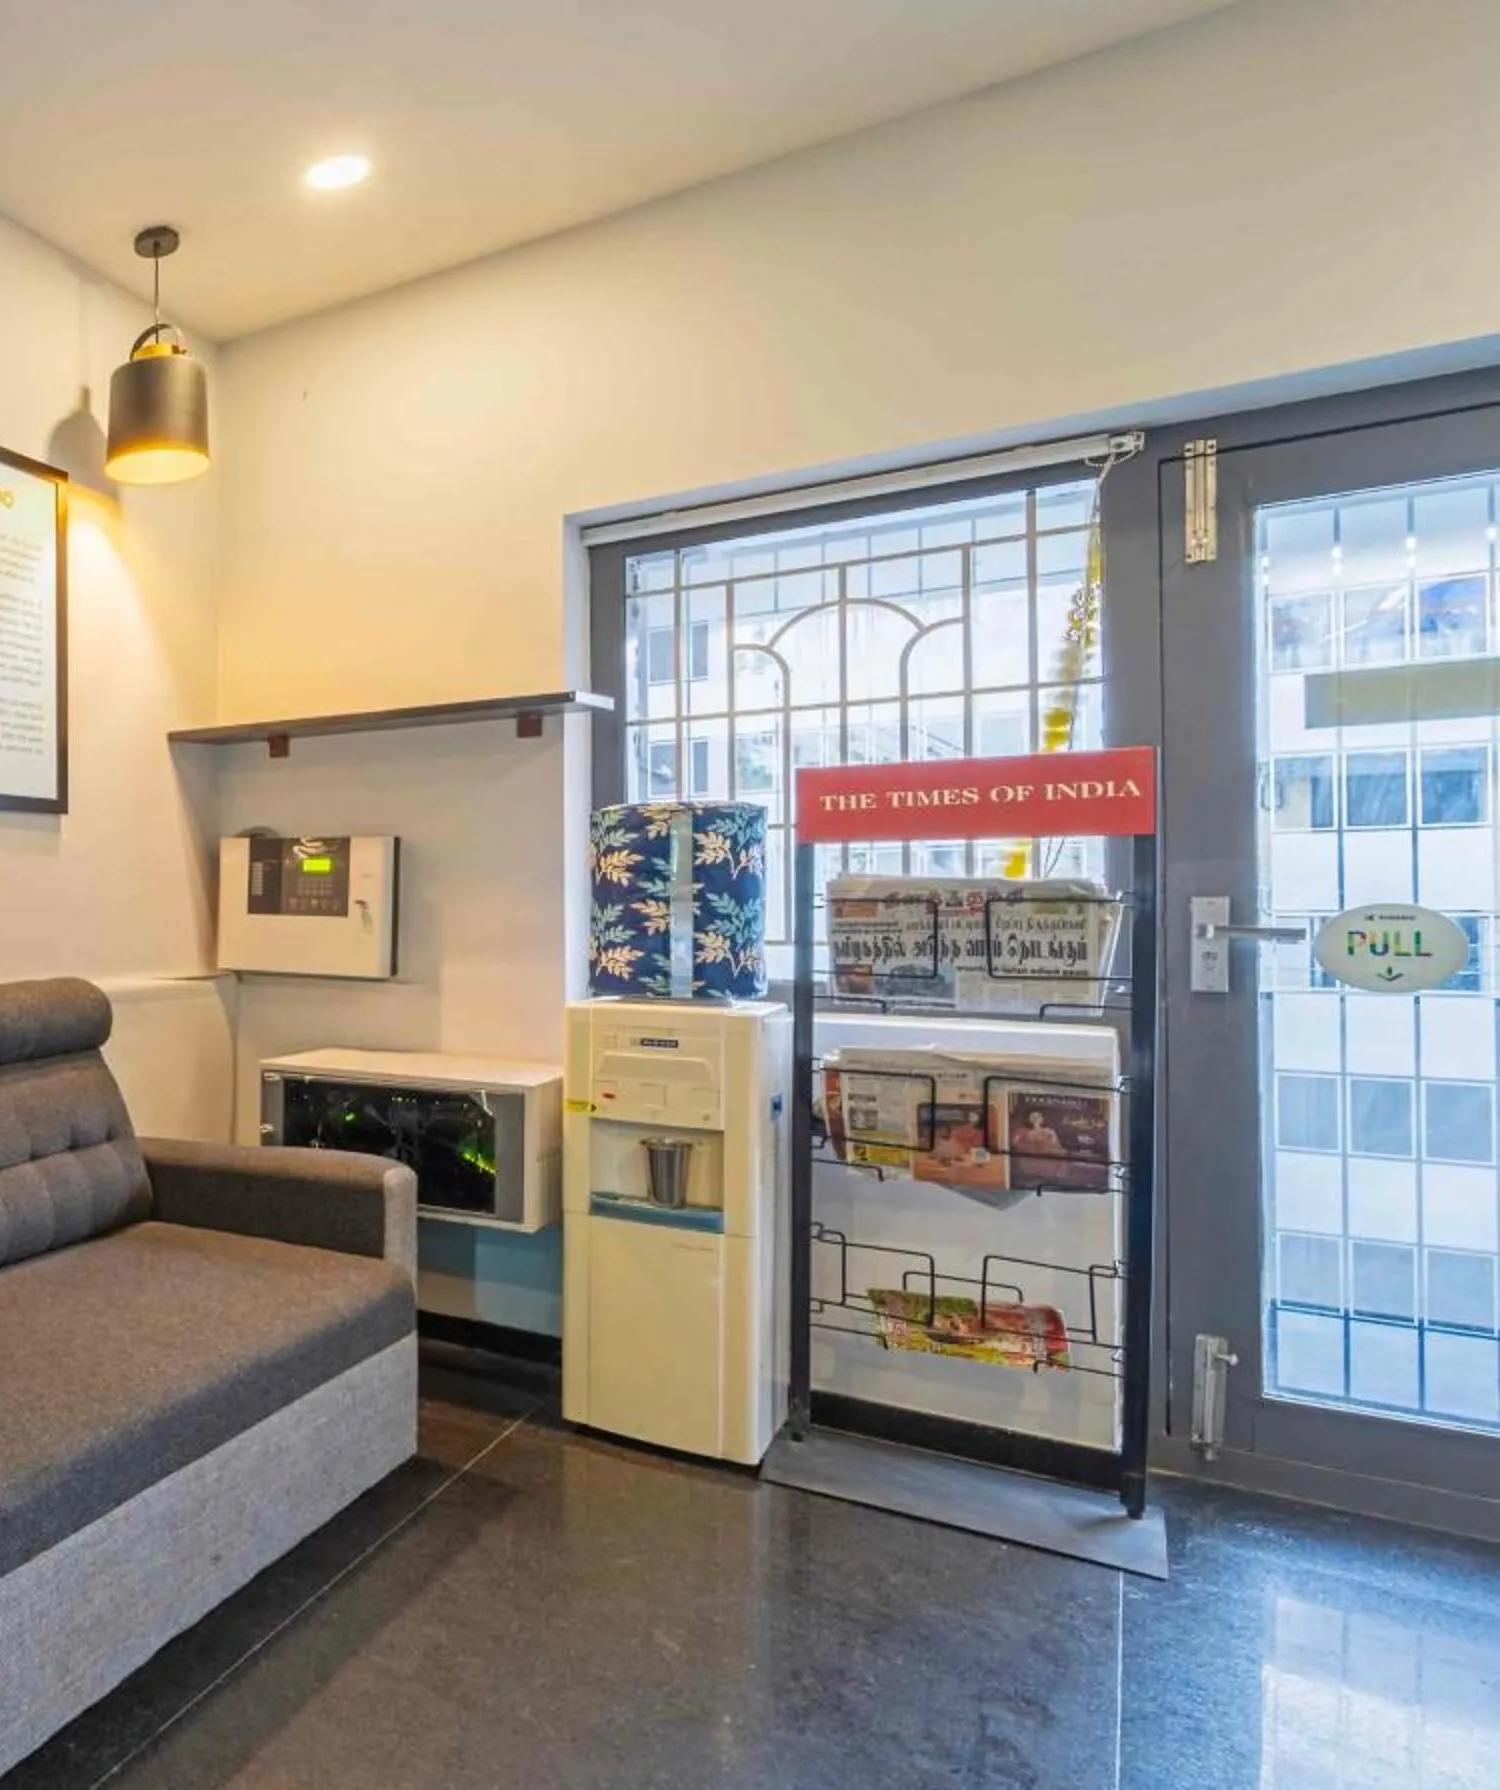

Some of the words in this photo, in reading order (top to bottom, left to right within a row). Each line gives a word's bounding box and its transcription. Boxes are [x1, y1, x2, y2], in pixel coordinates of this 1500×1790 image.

[819, 793, 877, 811] THE
[886, 787, 980, 809] TIMES
[989, 784, 1035, 802] OF
[1045, 779, 1142, 801] INDIA
[1347, 930, 1434, 957] PULL
